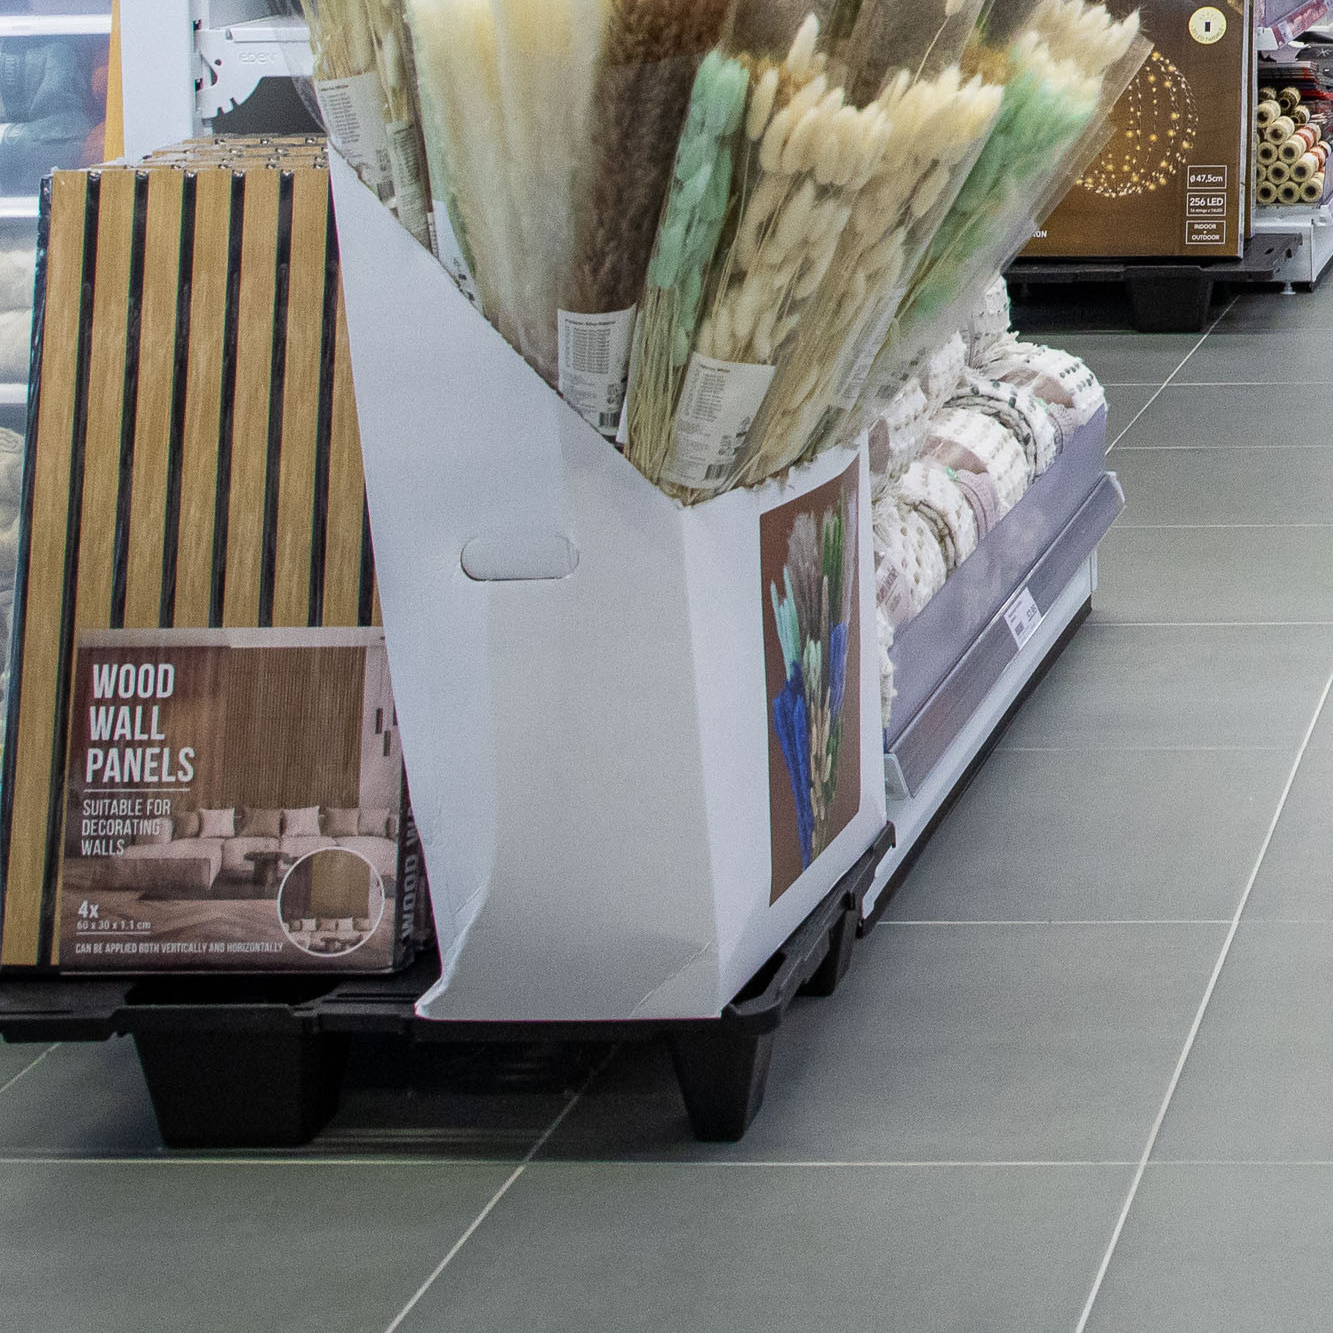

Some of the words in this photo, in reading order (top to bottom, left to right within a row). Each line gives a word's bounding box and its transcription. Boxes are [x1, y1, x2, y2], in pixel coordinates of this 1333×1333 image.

[1196, 174, 1223, 183] 47,5cm
[1189, 198, 1206, 206] 256
[1206, 198, 1224, 206] LED
[92, 663, 175, 699] WOOD
[89, 705, 165, 741] WALL
[85, 746, 195, 784] PANELS
[82, 799, 144, 817] SUITABLE
[146, 799, 171, 817] FOR
[81, 819, 161, 837] DECORATING
[80, 839, 126, 857] WALLS
[77, 900, 99, 919] 4x
[76, 921, 89, 931] 60
[75, 944, 92, 954] CAN
[93, 944, 103, 954] BE
[105, 943, 137, 954] APPLIED
[138, 943, 160, 954] BOTH
[161, 942, 206, 954] VERTICALLY
[208, 943, 226, 953] AND
[227, 942, 284, 954] HORIZONTALLY
